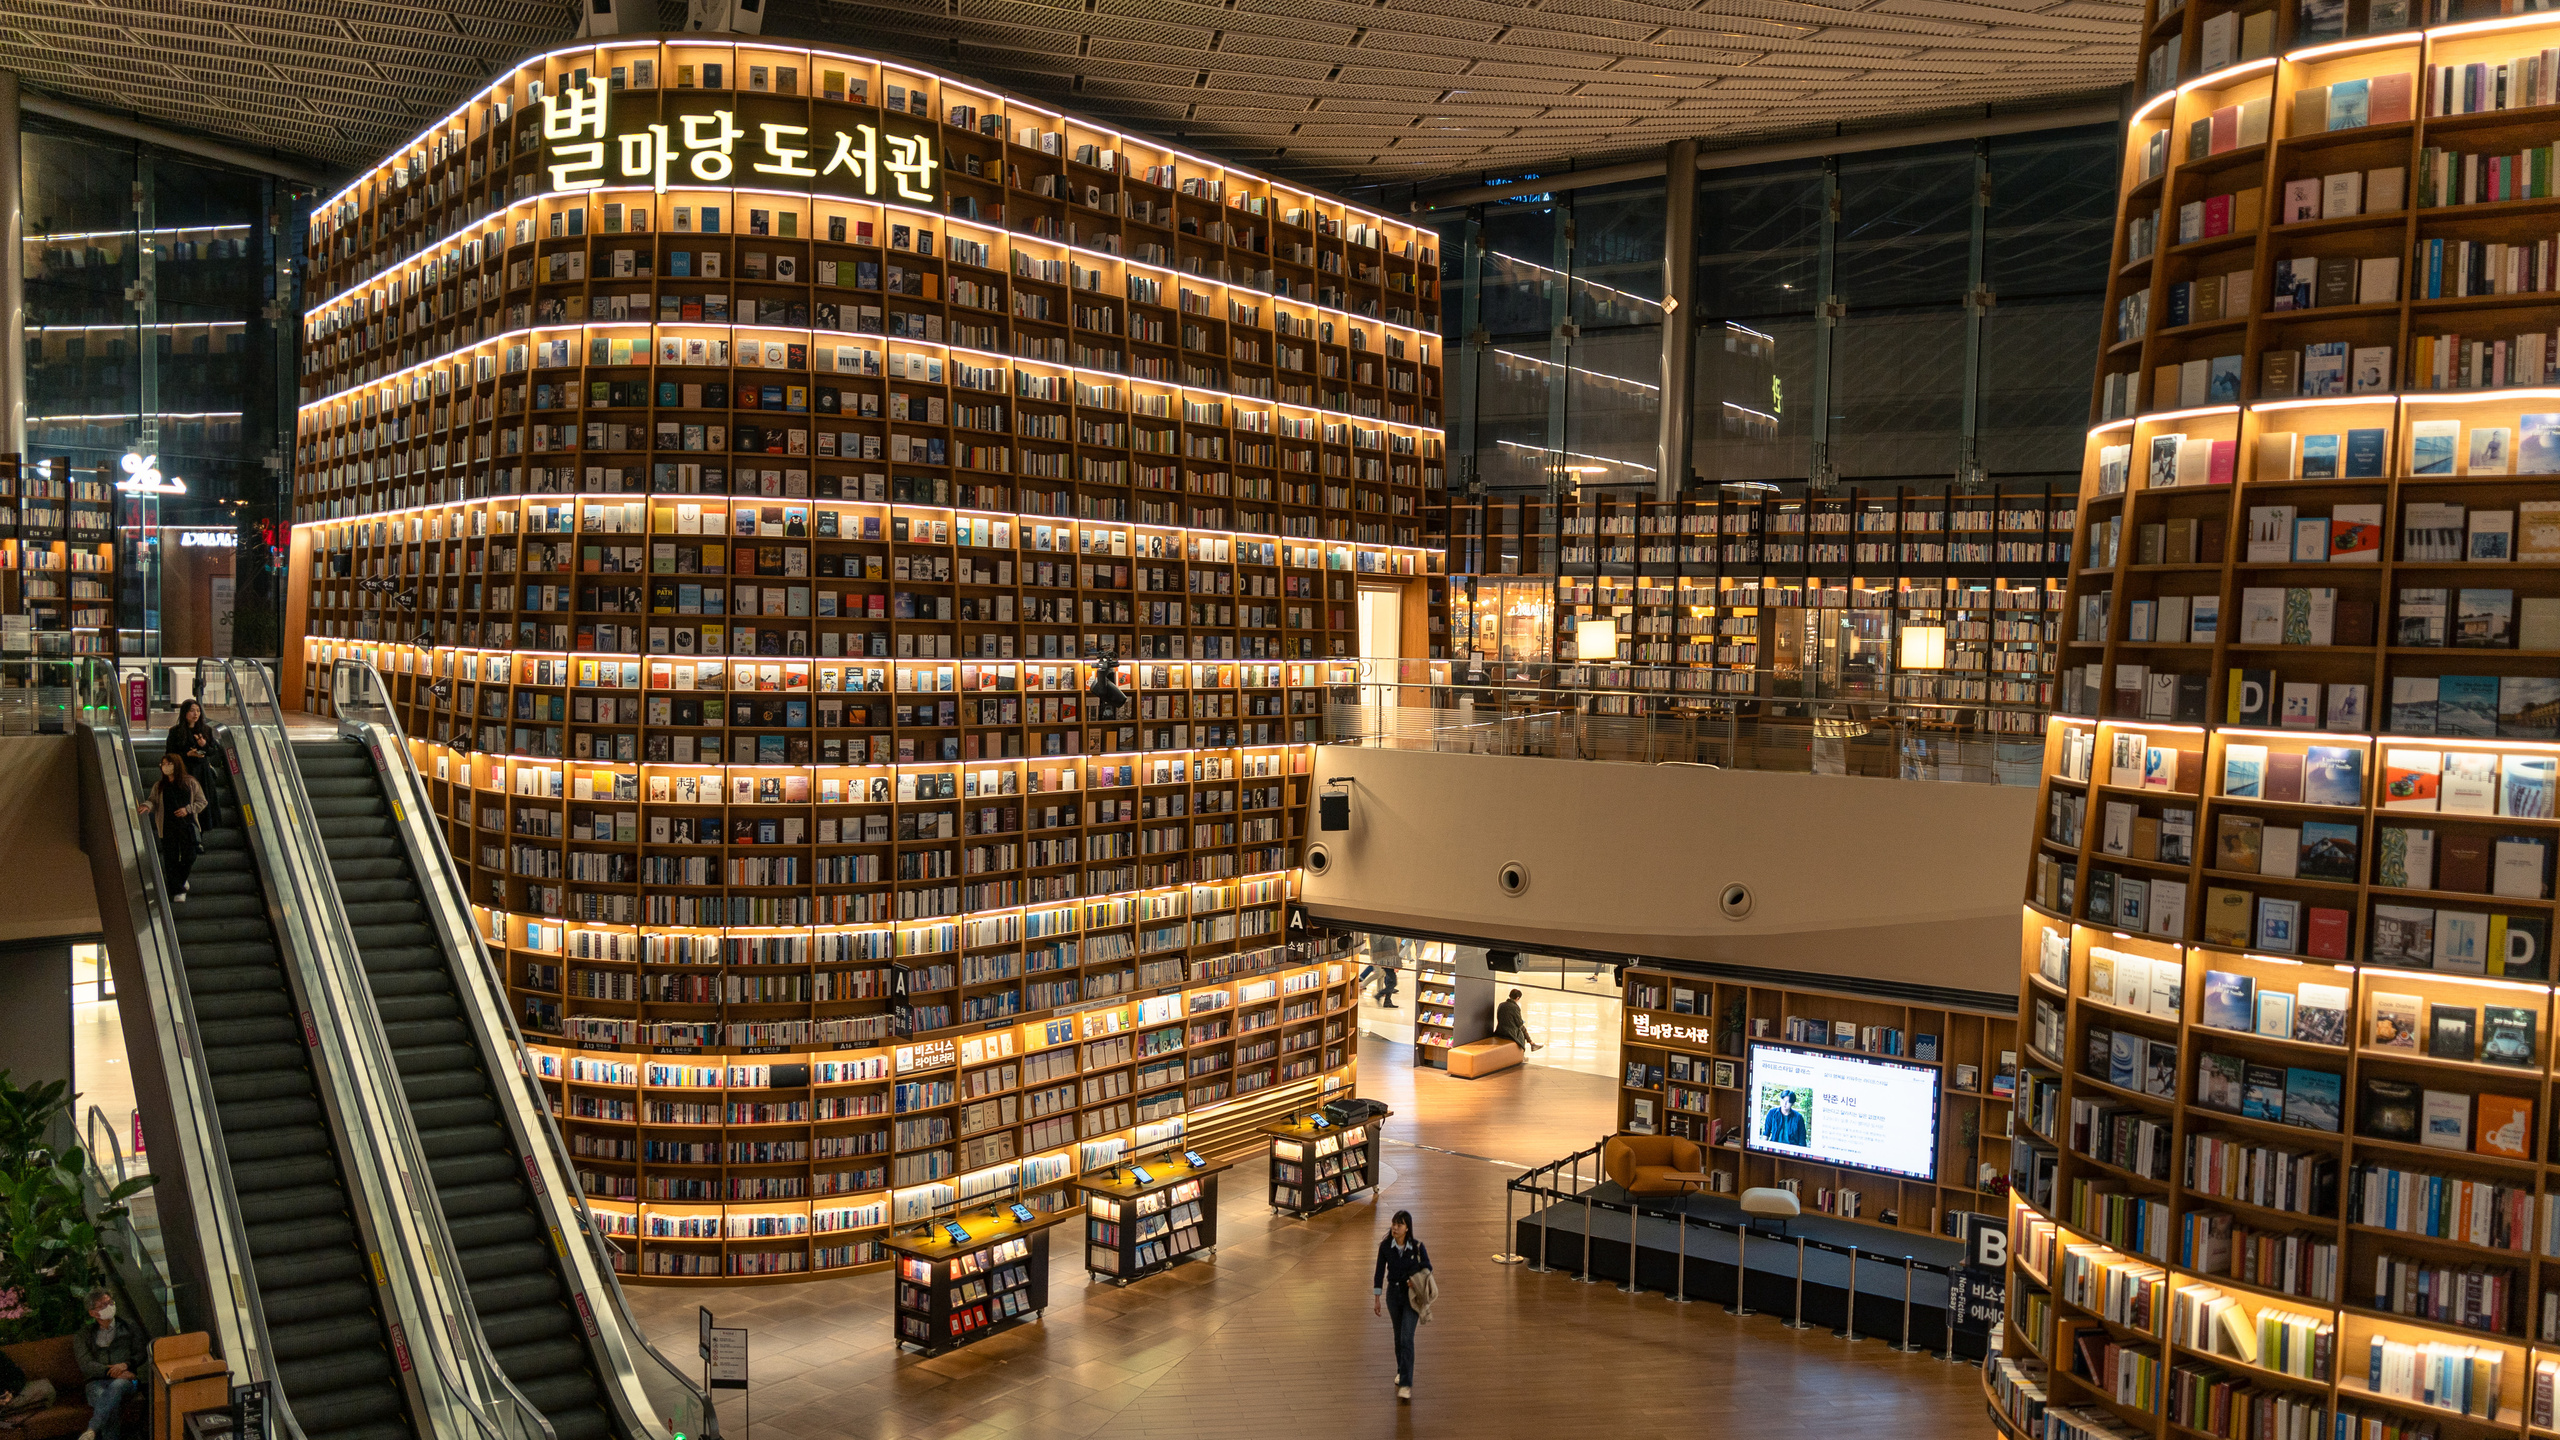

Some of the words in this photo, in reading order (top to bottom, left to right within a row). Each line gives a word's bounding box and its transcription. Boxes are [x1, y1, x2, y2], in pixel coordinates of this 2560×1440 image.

[541, 76, 745, 195] 별마당
[752, 123, 939, 203] 도서관
[2240, 681, 2264, 713] D
[1290, 910, 1304, 929] A
[1288, 940, 1305, 953] 소설
[2508, 931, 2535, 964] D
[896, 972, 906, 995] A
[1633, 1014, 1672, 1040] 별마당
[1673, 1025, 1710, 1044] 도서관
[914, 1039, 955, 1057] 비즈니스
[914, 1051, 955, 1069] 라이브러리
[1822, 1093, 1839, 1105] 박준
[1840, 1096, 1857, 1107] 시인
[1979, 1227, 2007, 1267] B
[1950, 1286, 1959, 1311] Essay
[1957, 1276, 1967, 1324] Non-Fiction
